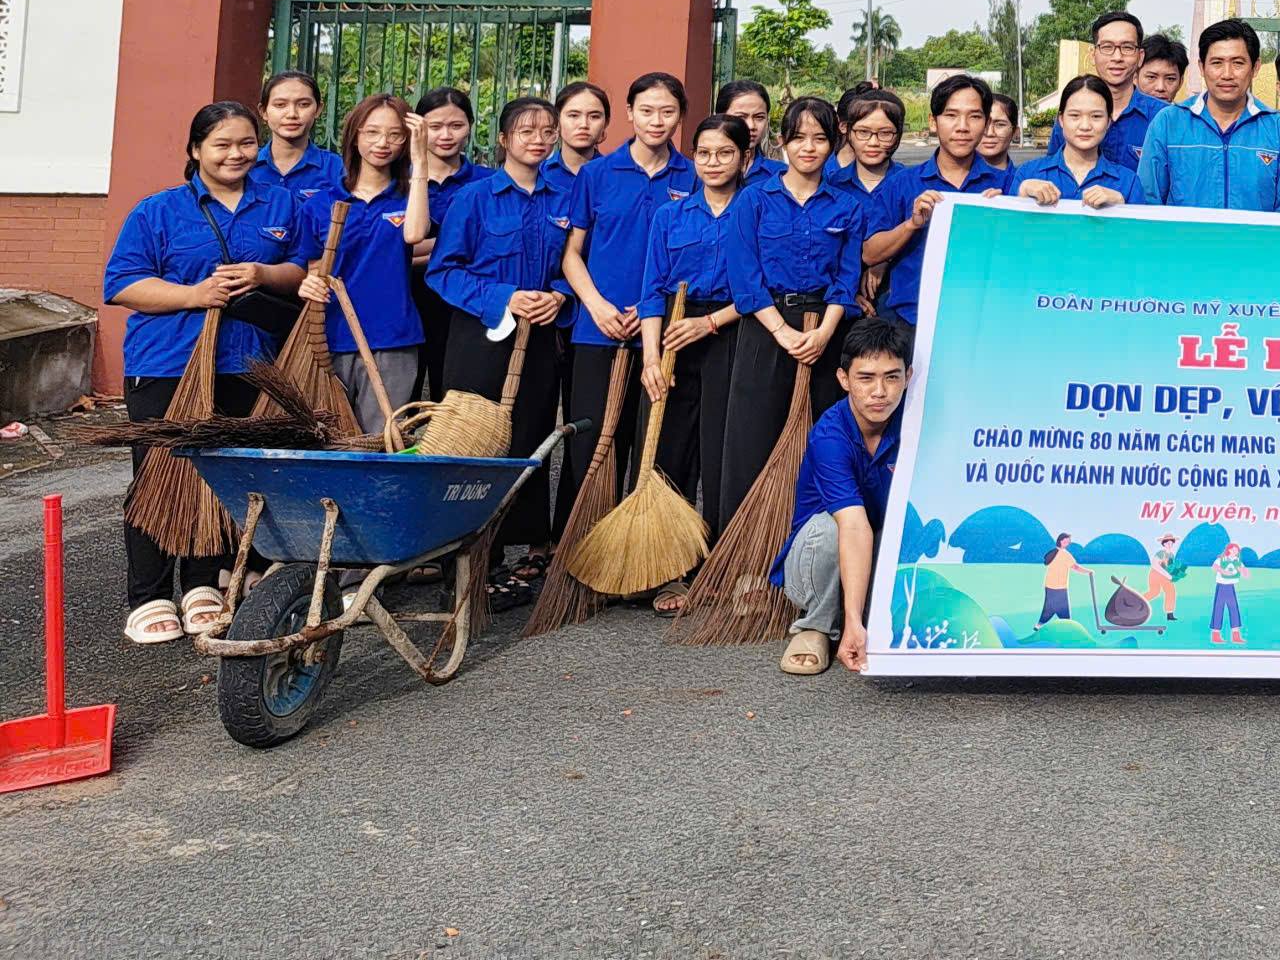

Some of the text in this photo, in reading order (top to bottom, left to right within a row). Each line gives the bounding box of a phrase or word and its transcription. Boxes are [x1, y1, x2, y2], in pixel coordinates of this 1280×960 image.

[1036, 294, 1094, 312] ĐOÀN
[1101, 297, 1186, 315] PHƯỜNG
[1192, 301, 1222, 316] MỸ
[1178, 324, 1248, 370] LỄ
[1065, 381, 1143, 419] DỌN
[1153, 384, 1234, 421] DẸP,
[973, 425, 1023, 449] CHÀO
[1028, 426, 1084, 451] MỪNG
[1089, 431, 1113, 452] 80
[1117, 428, 1161, 453] NĂM
[1166, 431, 1216, 455] CÁCH
[1221, 434, 1276, 459] MẠNG
[965, 458, 988, 483] VÀ
[994, 456, 1046, 486] QUỐC
[1050, 461, 1115, 486] KHÁNH
[1120, 462, 1172, 488] NƯỚC
[1178, 464, 1228, 492] CỘNG
[1234, 464, 1271, 489] HOÀ
[1140, 502, 1175, 523] Mỹ
[1180, 502, 1257, 523] Xuyên,
